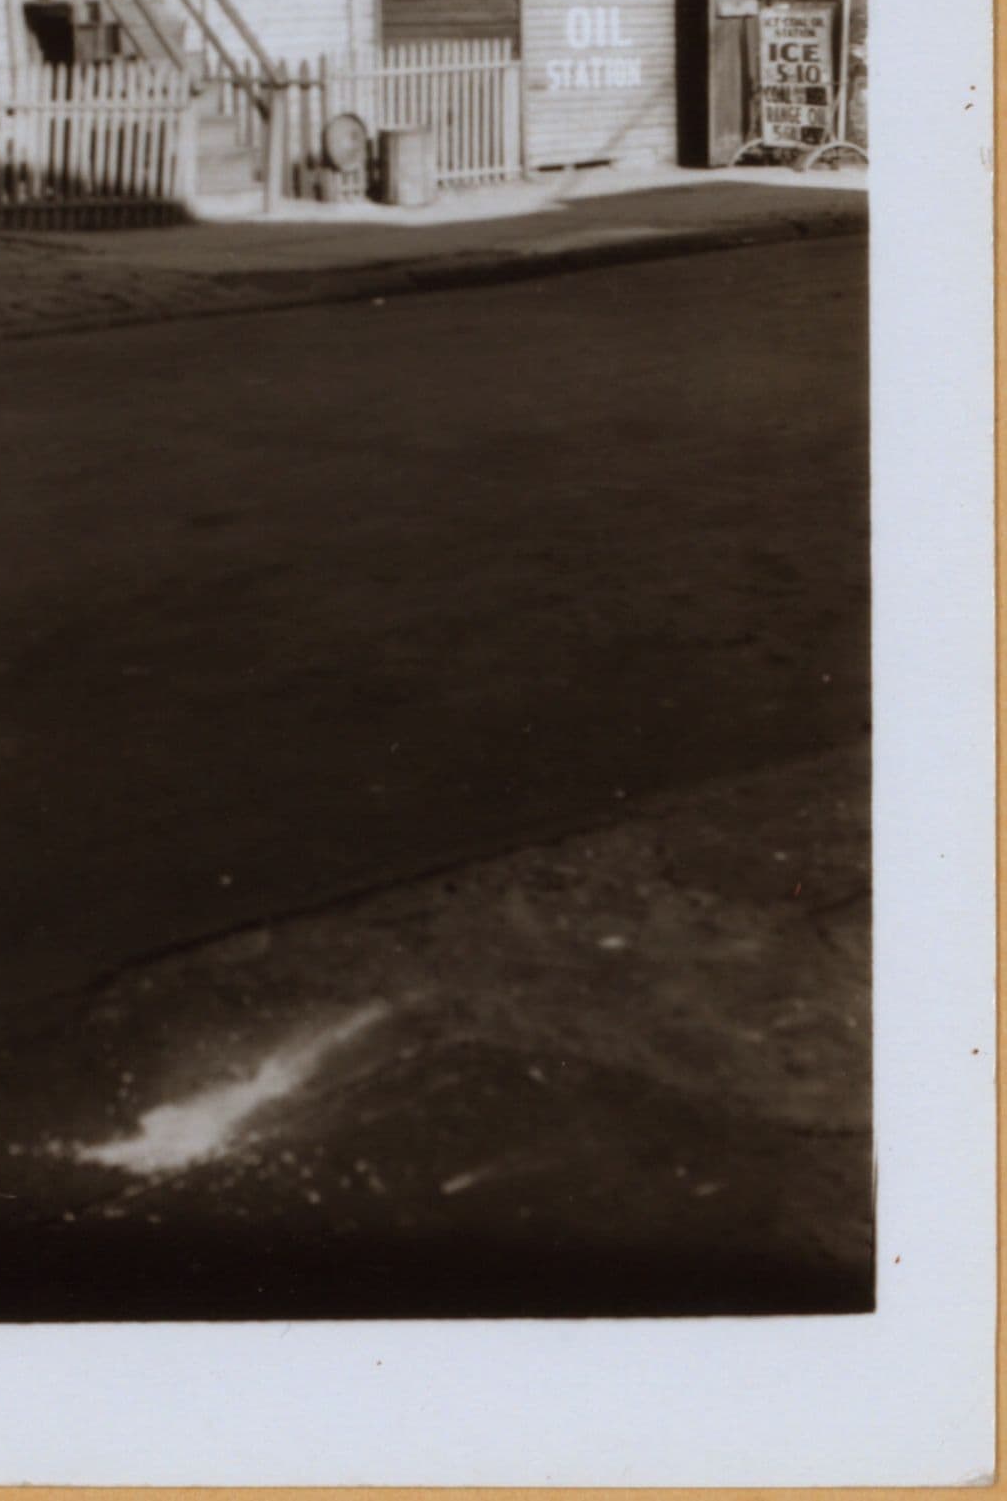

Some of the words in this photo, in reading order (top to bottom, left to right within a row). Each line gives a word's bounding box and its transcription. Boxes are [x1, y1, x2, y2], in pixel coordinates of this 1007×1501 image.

[566, 6, 633, 48] OIL
[769, 43, 820, 62] ICE
[546, 56, 643, 92] STATION
